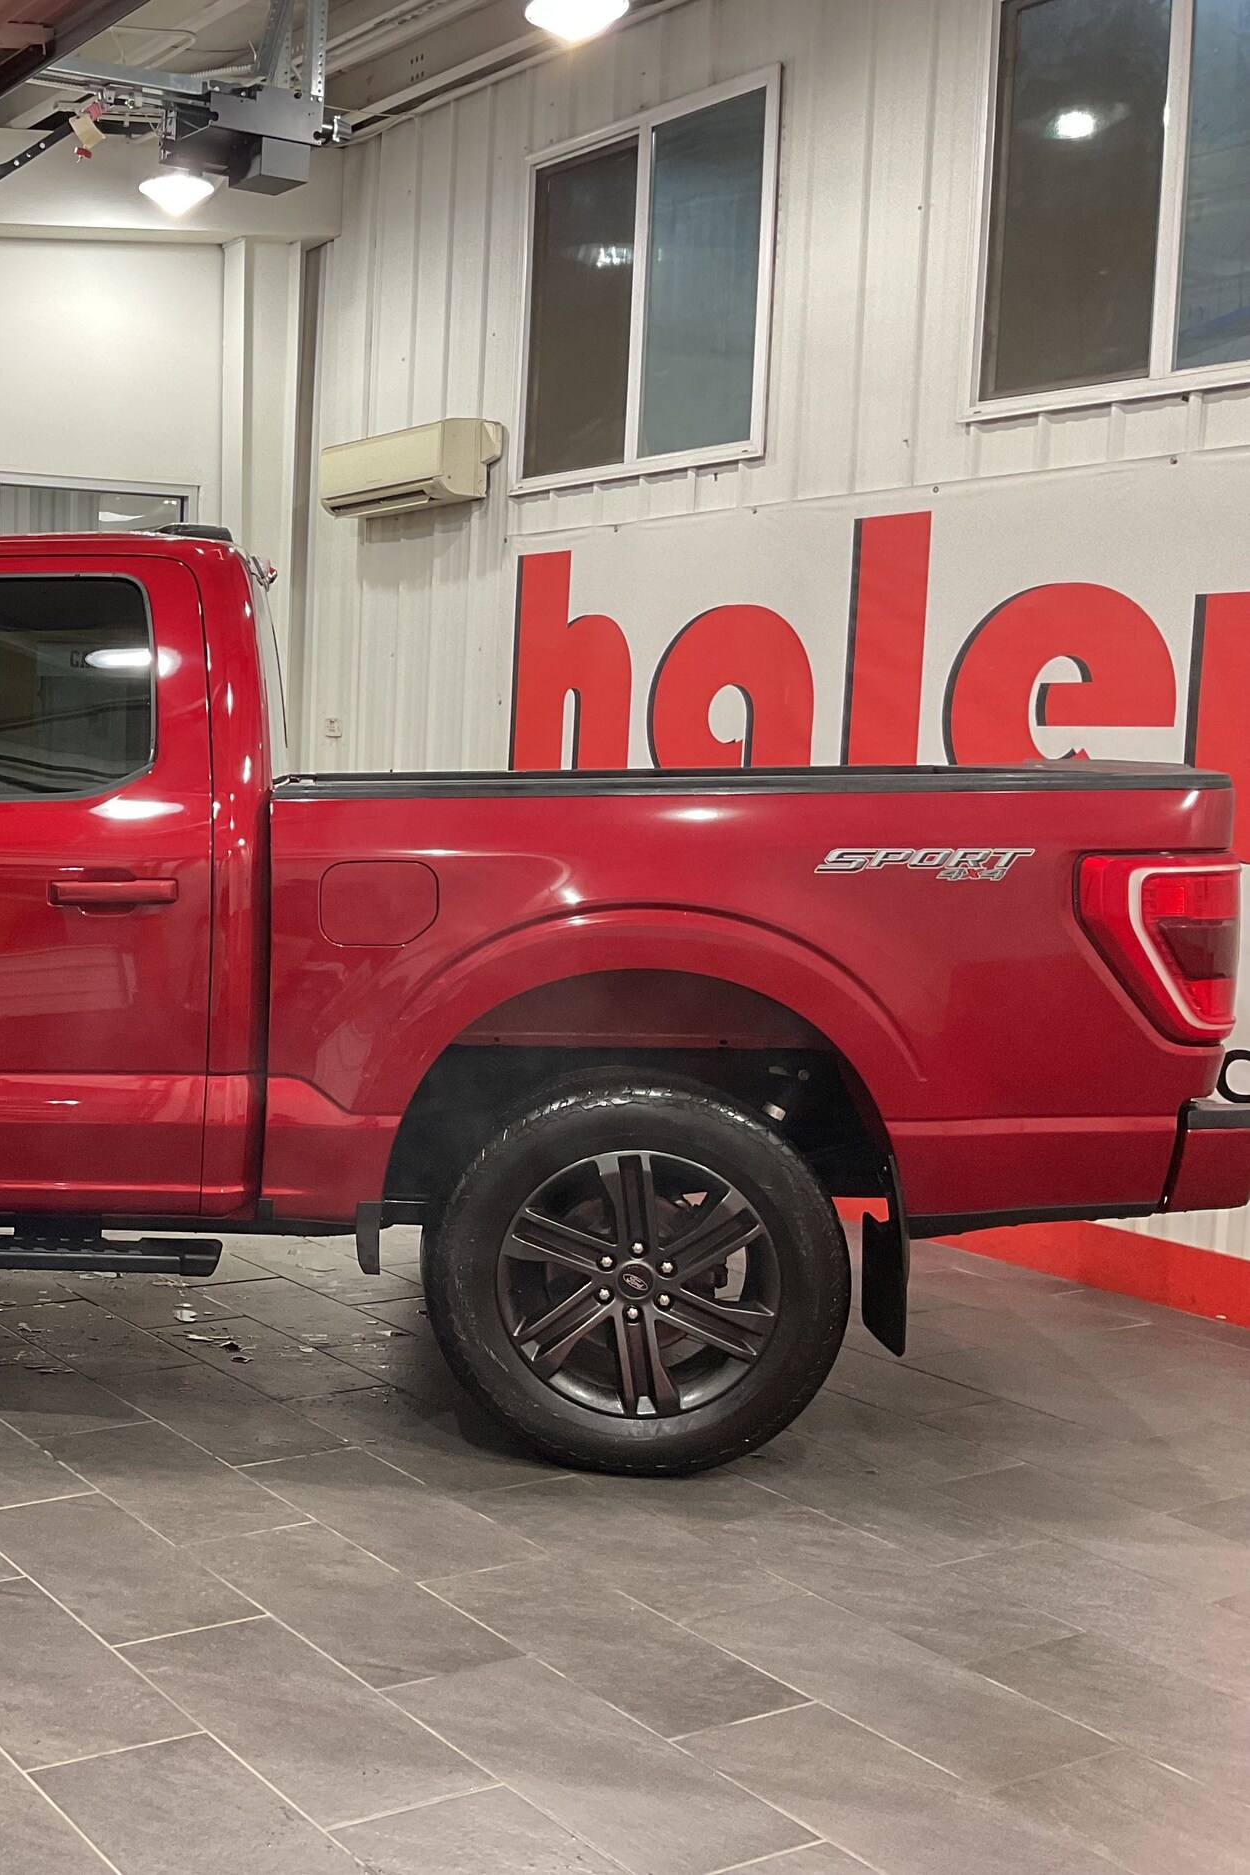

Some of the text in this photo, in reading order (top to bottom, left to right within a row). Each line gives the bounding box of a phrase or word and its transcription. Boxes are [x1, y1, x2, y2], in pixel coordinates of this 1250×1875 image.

[509, 511, 1250, 864] hale
[814, 848, 1035, 873] SPORT
[936, 868, 1007, 882] 4x4
